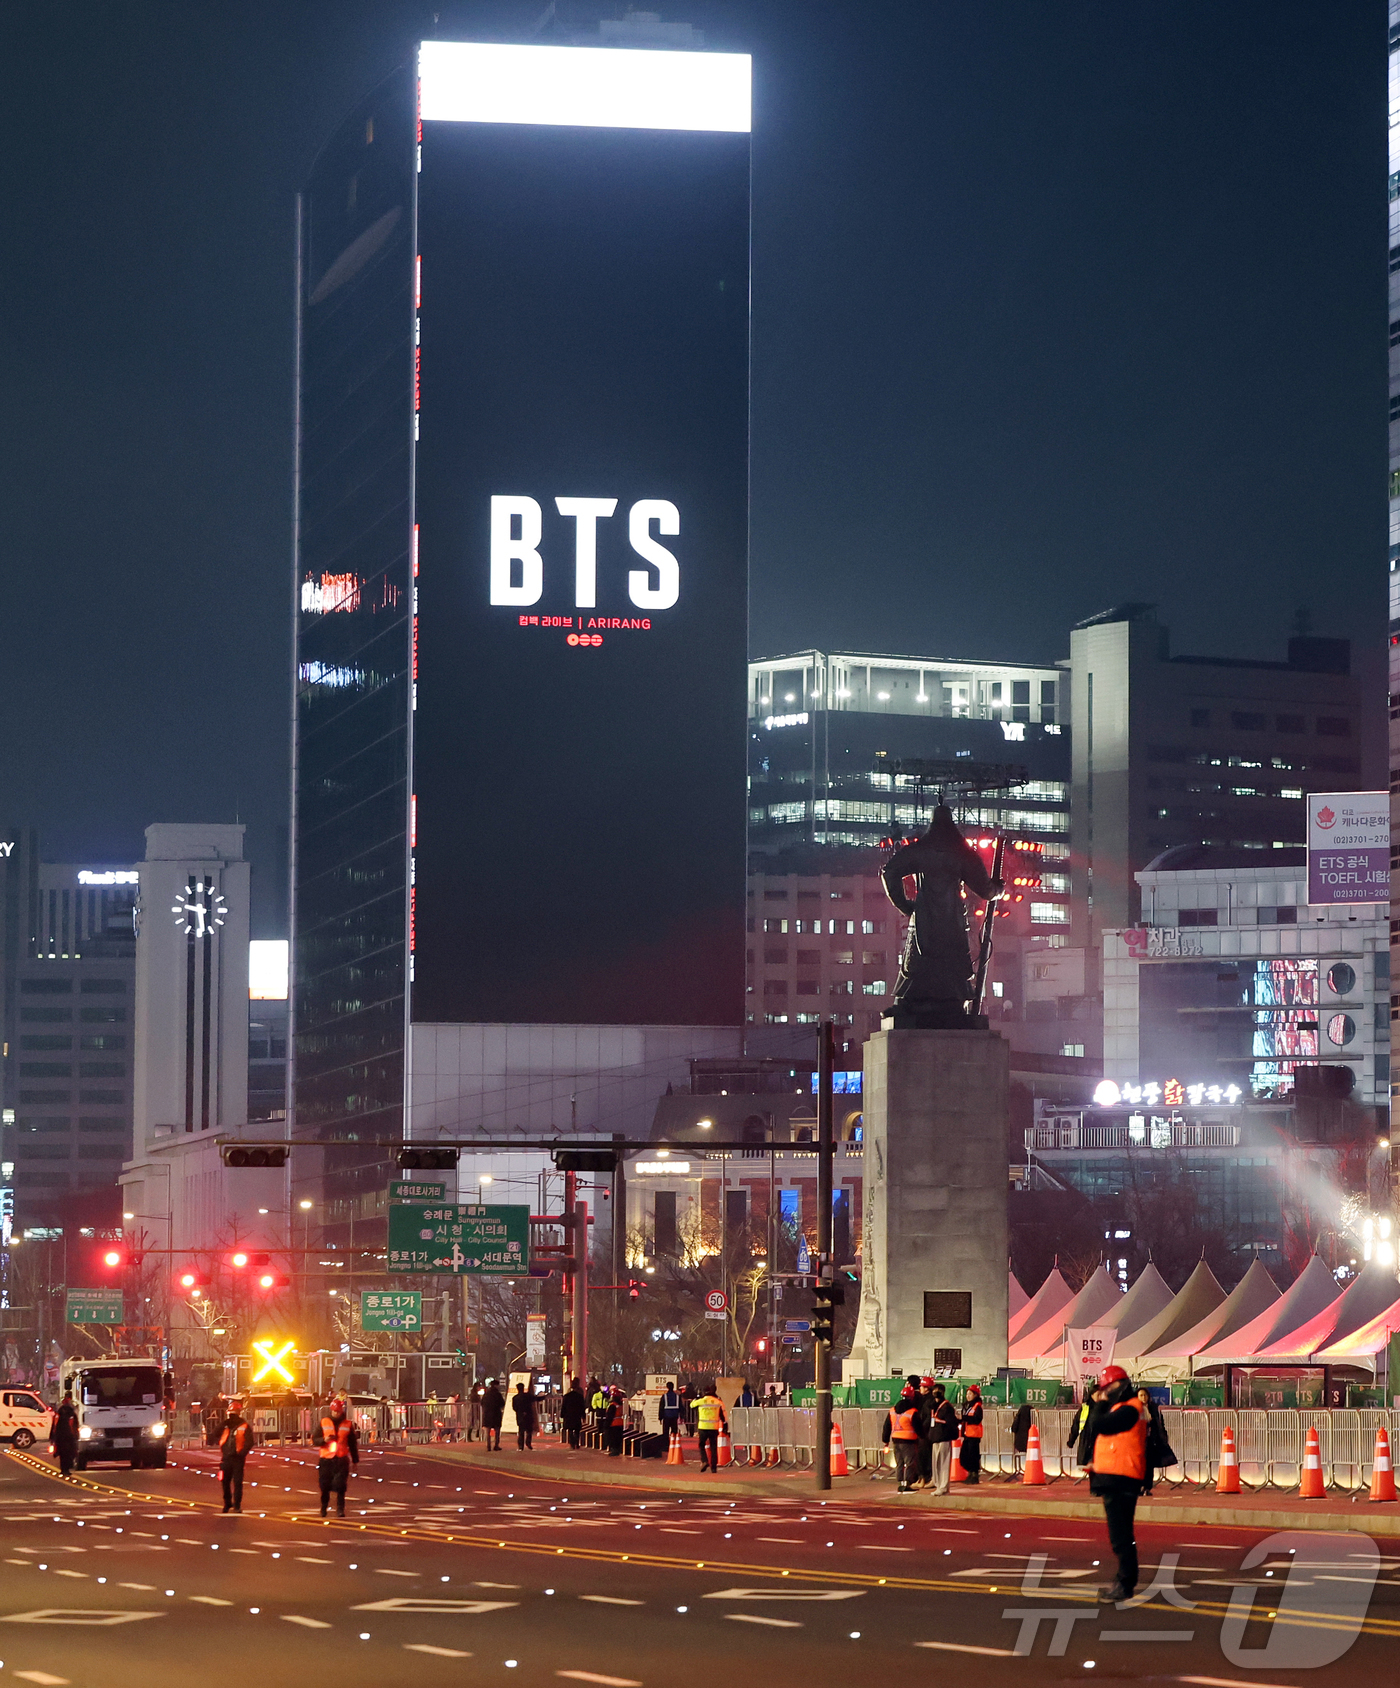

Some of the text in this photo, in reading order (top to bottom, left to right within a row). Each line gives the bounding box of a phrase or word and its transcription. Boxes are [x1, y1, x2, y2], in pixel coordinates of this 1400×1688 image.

[490, 495, 680, 610] BTS
[519, 615, 652, 630] 컴백 라이브 ARIRANG
[1319, 855, 1369, 869] ETS 공식
[1319, 871, 1362, 884] TOEFL
[1149, 947, 1202, 957] 722-8272
[396, 1186, 441, 1197] 세종대로사거리
[423, 1209, 453, 1221] 숭례문
[389, 1251, 429, 1262] 종로1가
[482, 1252, 522, 1263] 서대문역
[366, 1295, 415, 1308] 종로1가
[710, 1295, 723, 1306] 50
[1082, 1339, 1103, 1351] BTS
[869, 1389, 891, 1402] BTS
[1026, 1388, 1047, 1402] BTS
